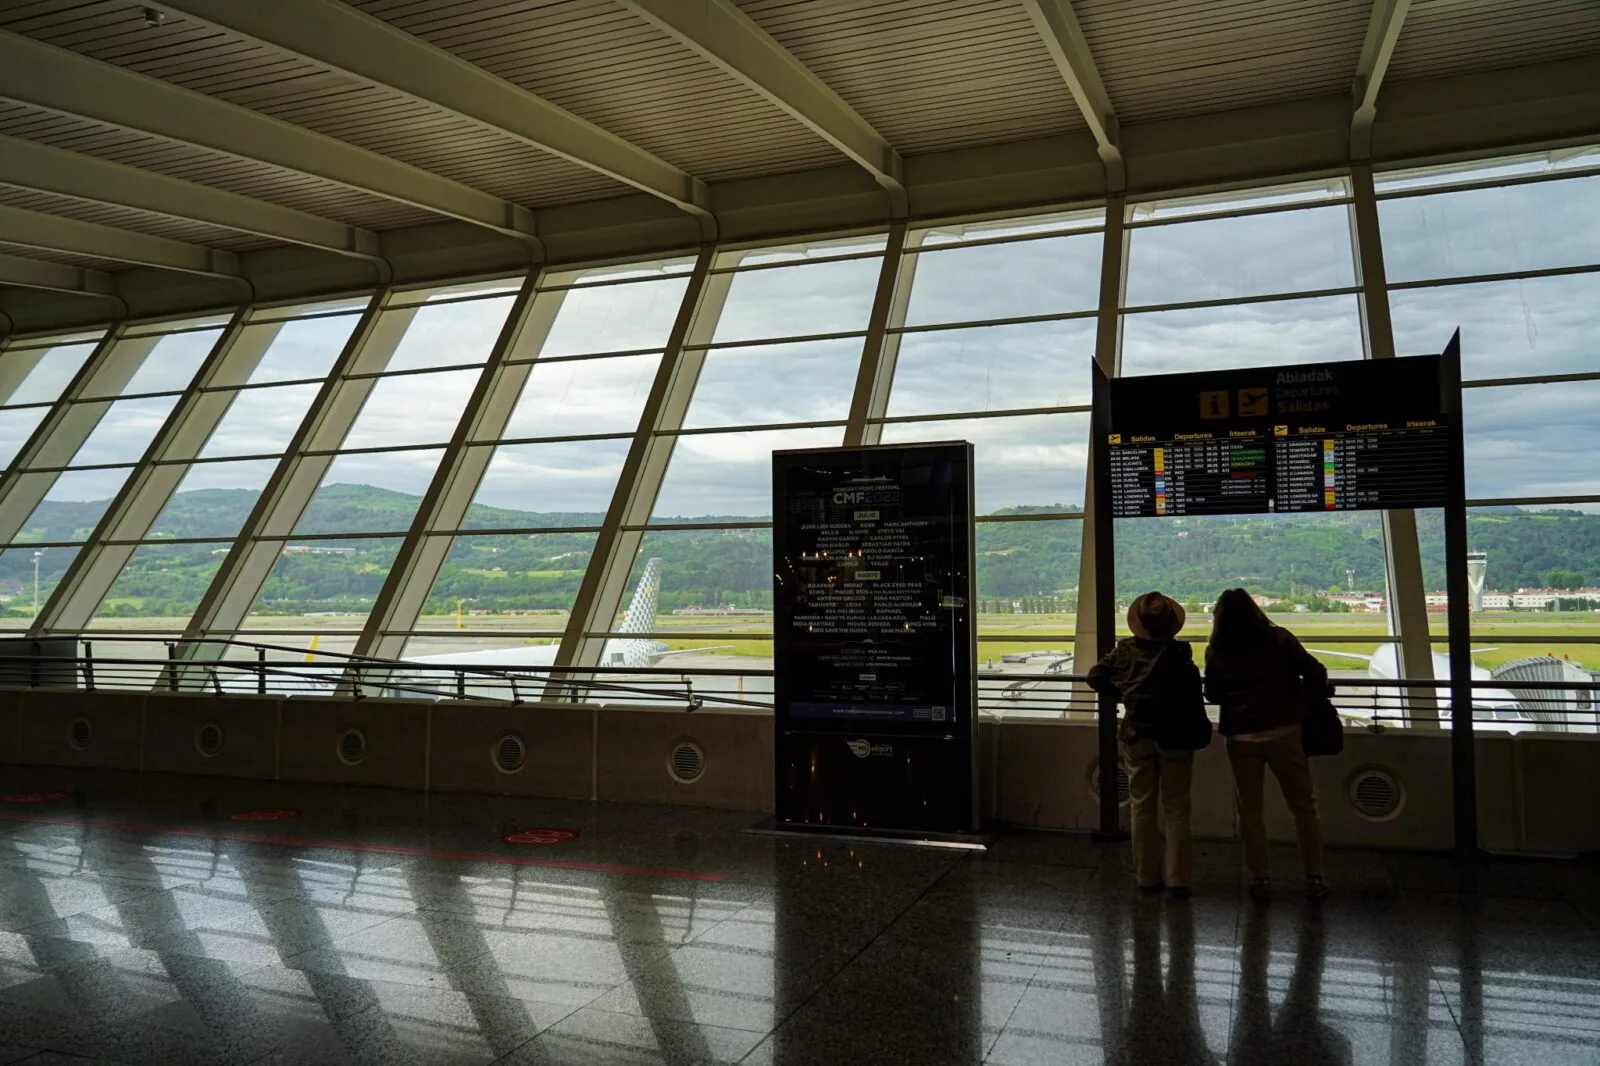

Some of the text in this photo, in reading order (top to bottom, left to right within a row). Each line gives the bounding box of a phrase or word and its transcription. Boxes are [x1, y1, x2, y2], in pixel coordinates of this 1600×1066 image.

[1276, 368, 1334, 384] Abiadak
[1276, 384, 1340, 400] Departures
[1278, 399, 1330, 414] Salidas
[1174, 432, 1212, 440] Departures
